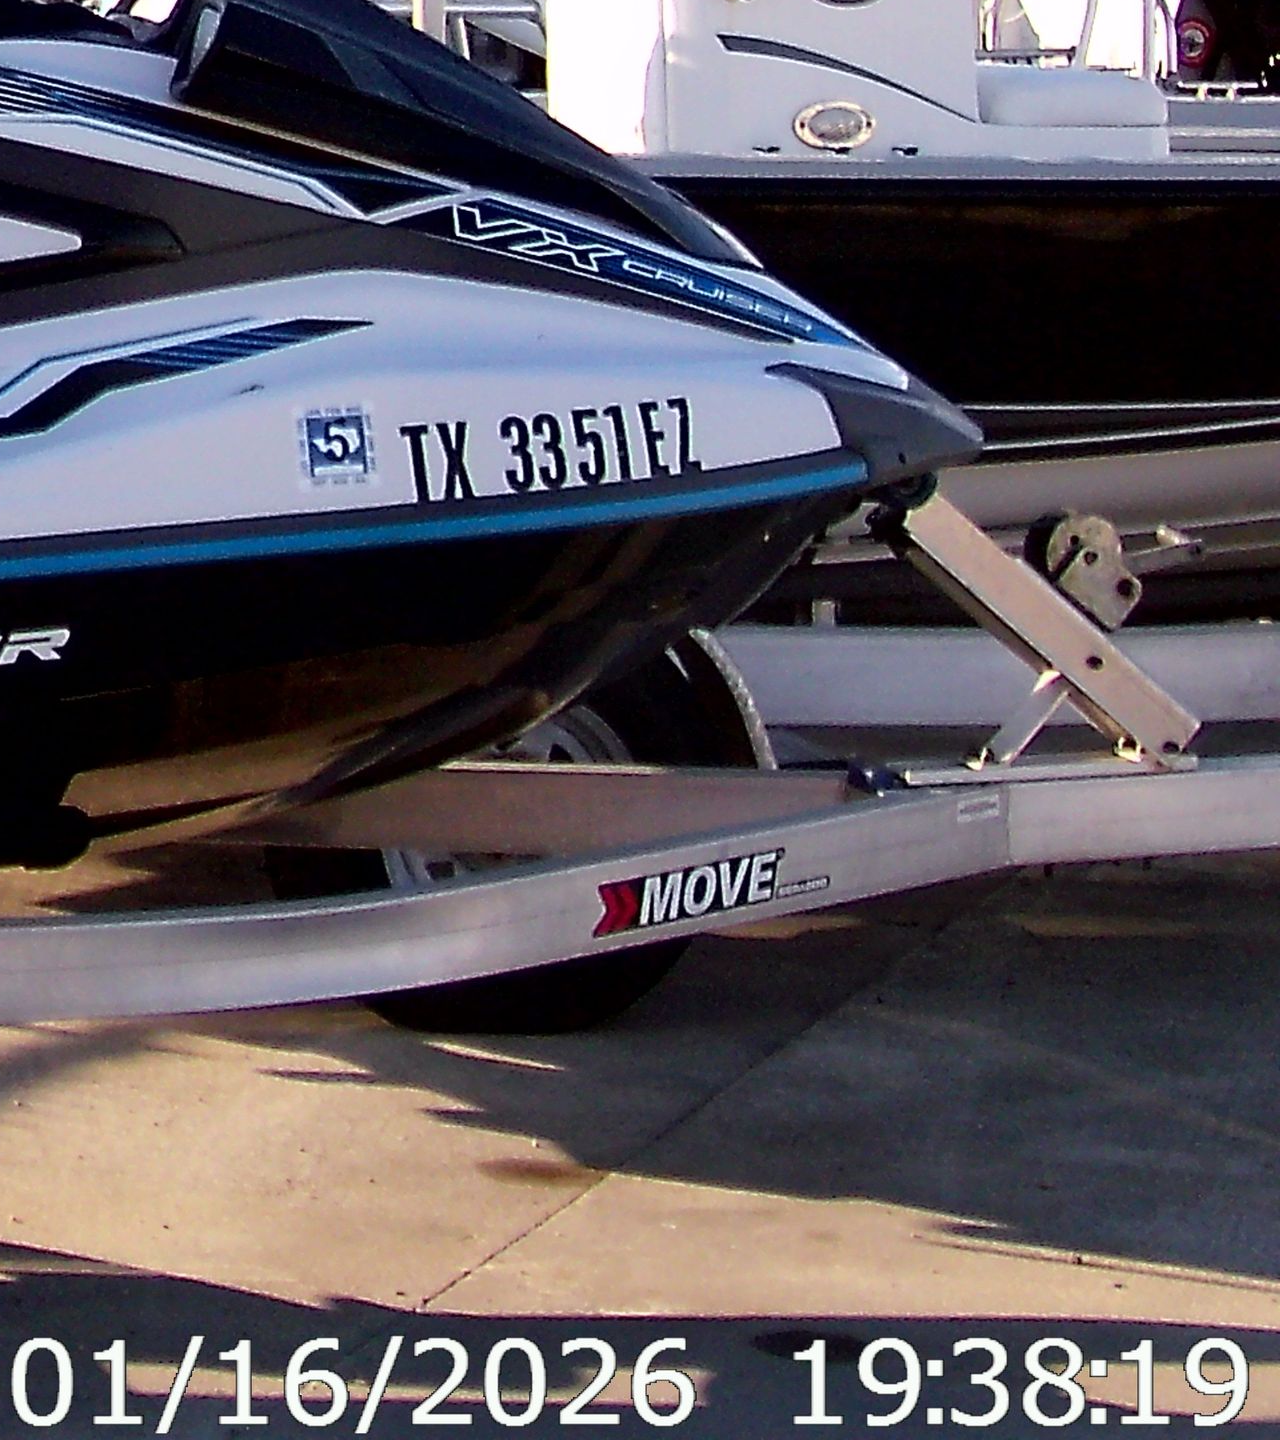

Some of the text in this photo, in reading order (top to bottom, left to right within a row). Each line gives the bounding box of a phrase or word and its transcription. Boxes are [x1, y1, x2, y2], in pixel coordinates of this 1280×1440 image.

[452, 204, 626, 272] VX
[399, 421, 476, 503] TX
[639, 852, 777, 926] MOVE
